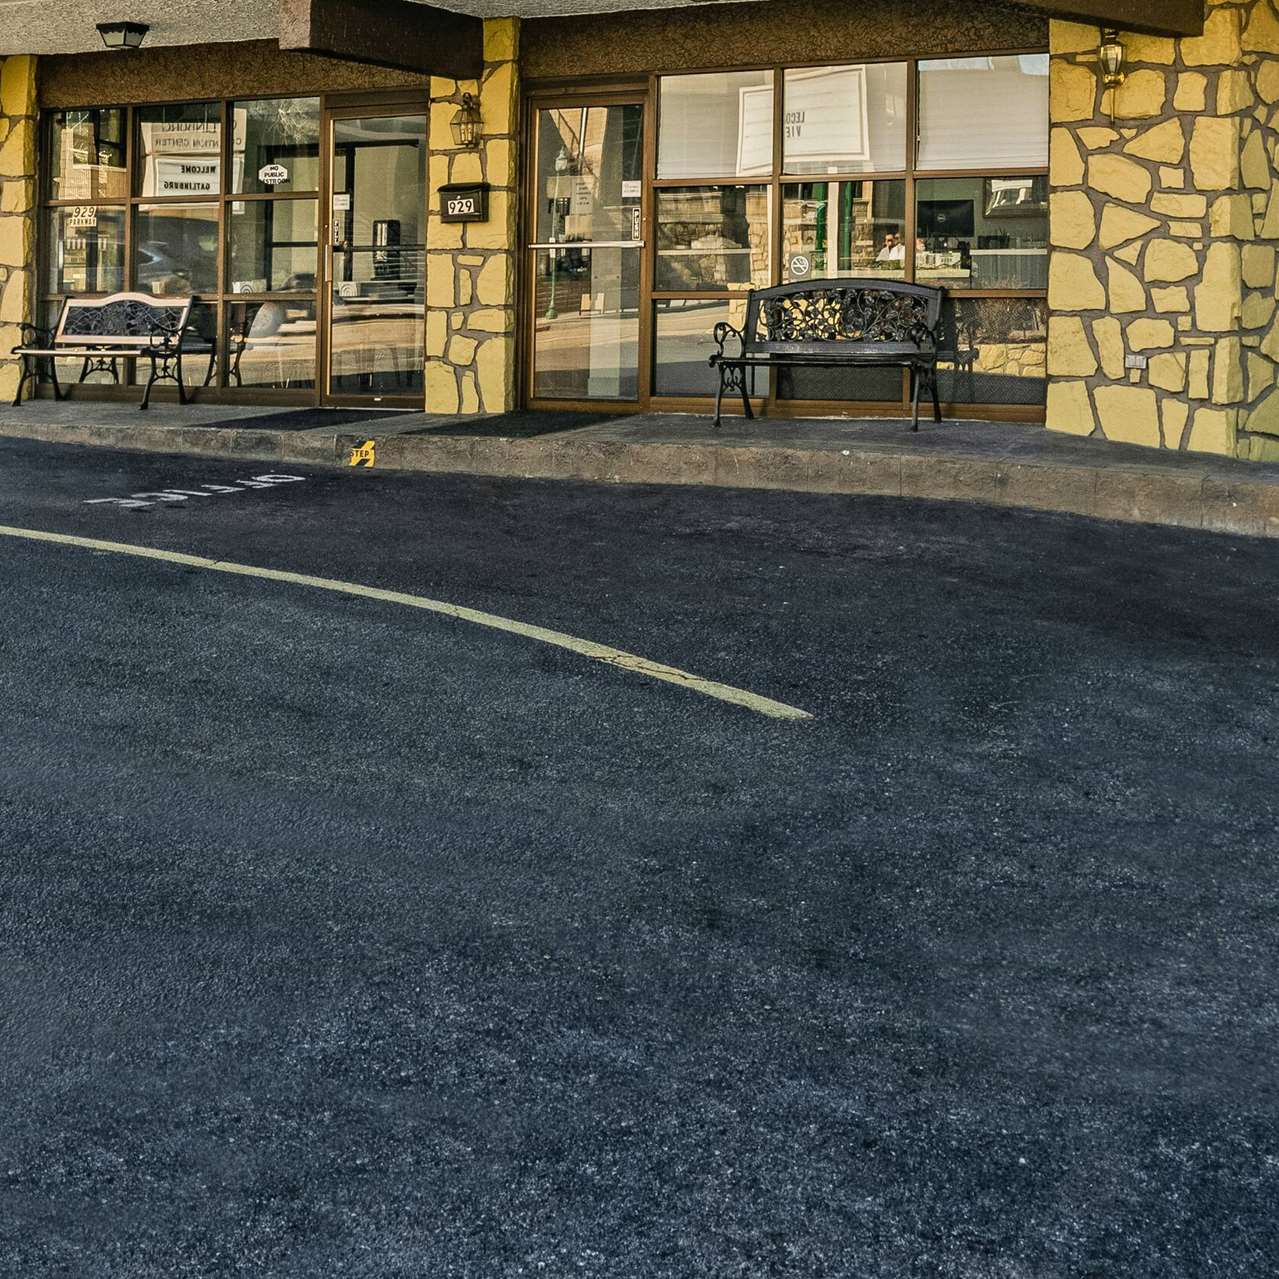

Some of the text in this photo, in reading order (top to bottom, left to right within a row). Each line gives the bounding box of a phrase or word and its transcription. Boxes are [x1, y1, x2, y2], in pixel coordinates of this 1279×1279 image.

[73, 206, 95, 218] 929
[449, 200, 473, 214] 929
[348, 449, 370, 458] STEP
